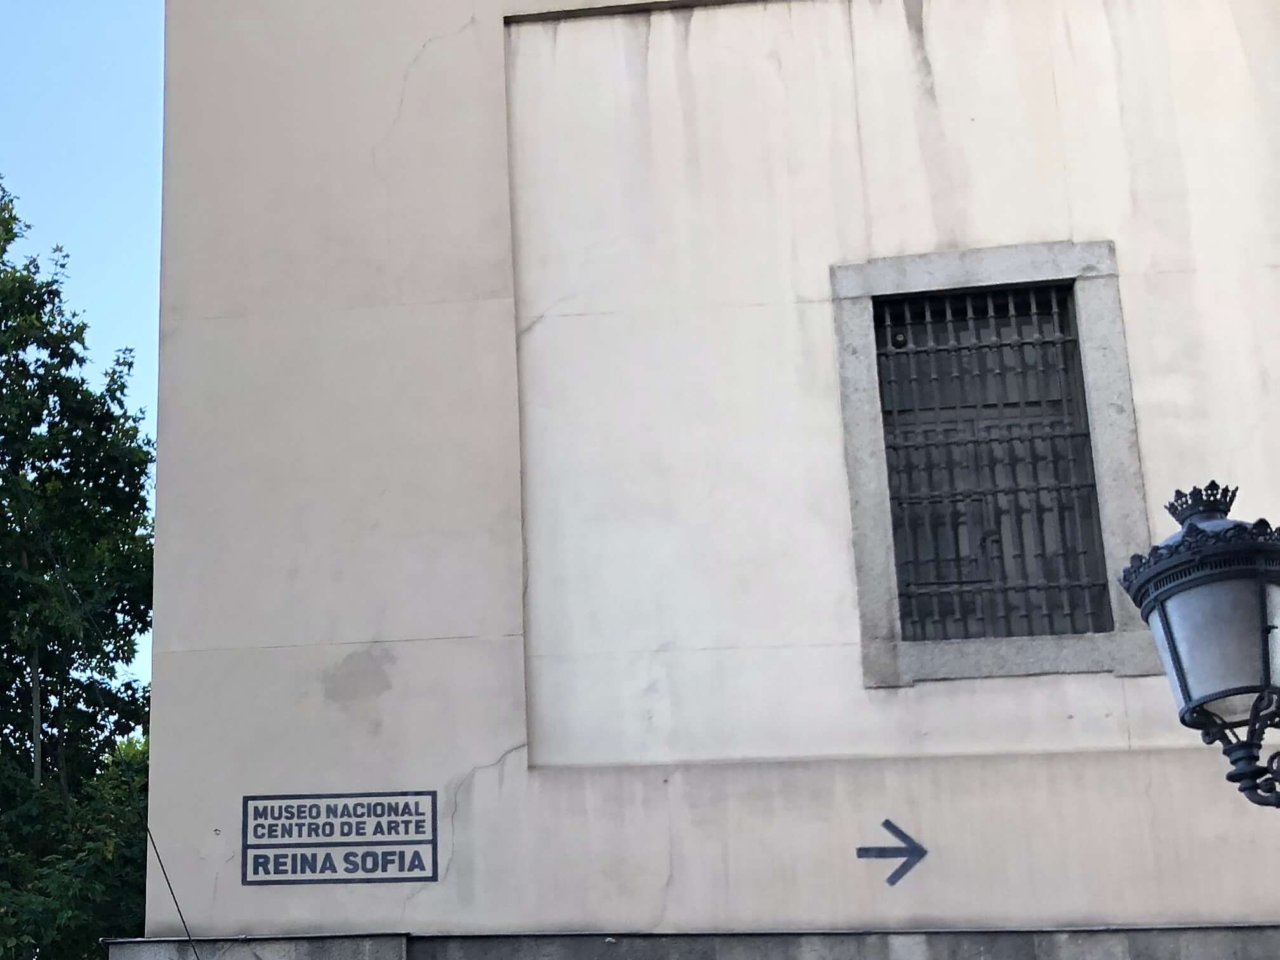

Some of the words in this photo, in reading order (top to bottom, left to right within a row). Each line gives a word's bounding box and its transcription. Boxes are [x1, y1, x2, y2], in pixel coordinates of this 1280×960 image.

[253, 804, 320, 821] MUSEO
[326, 801, 426, 819] NACIONAL
[253, 821, 335, 839] CENTRO
[340, 821, 367, 837] DE
[372, 819, 427, 836] ARTE
[253, 853, 338, 876] REINA
[343, 850, 427, 874] SOFIA
